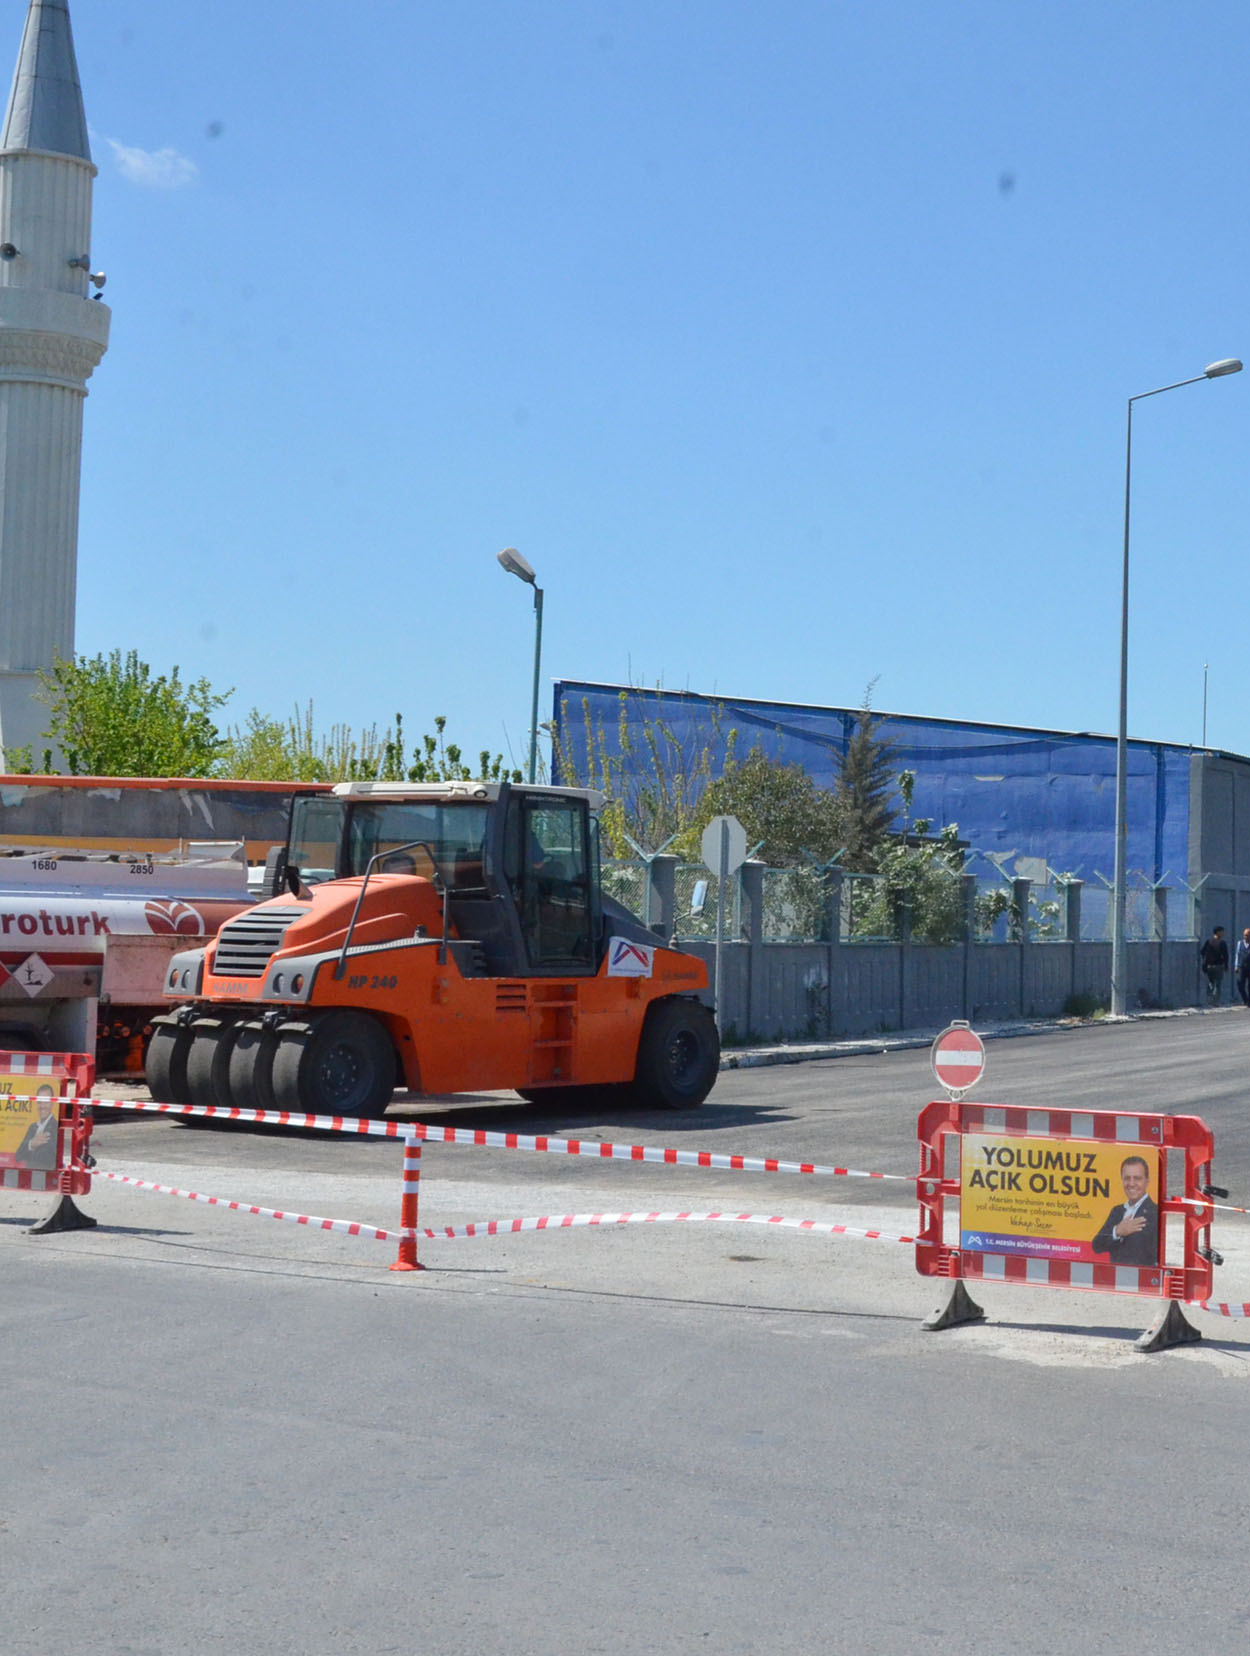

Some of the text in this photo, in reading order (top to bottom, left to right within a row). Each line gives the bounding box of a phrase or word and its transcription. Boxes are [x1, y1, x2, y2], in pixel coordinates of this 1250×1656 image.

[32, 860, 57, 871] 1680
[129, 864, 154, 875] 2850
[0, 909, 112, 936] roturk
[212, 982, 248, 994] HAMM
[348, 975, 398, 989] HP 240
[982, 1146, 1097, 1173] YOLUMUZ
[969, 1169, 1110, 1198] AÇIK OLSUN
